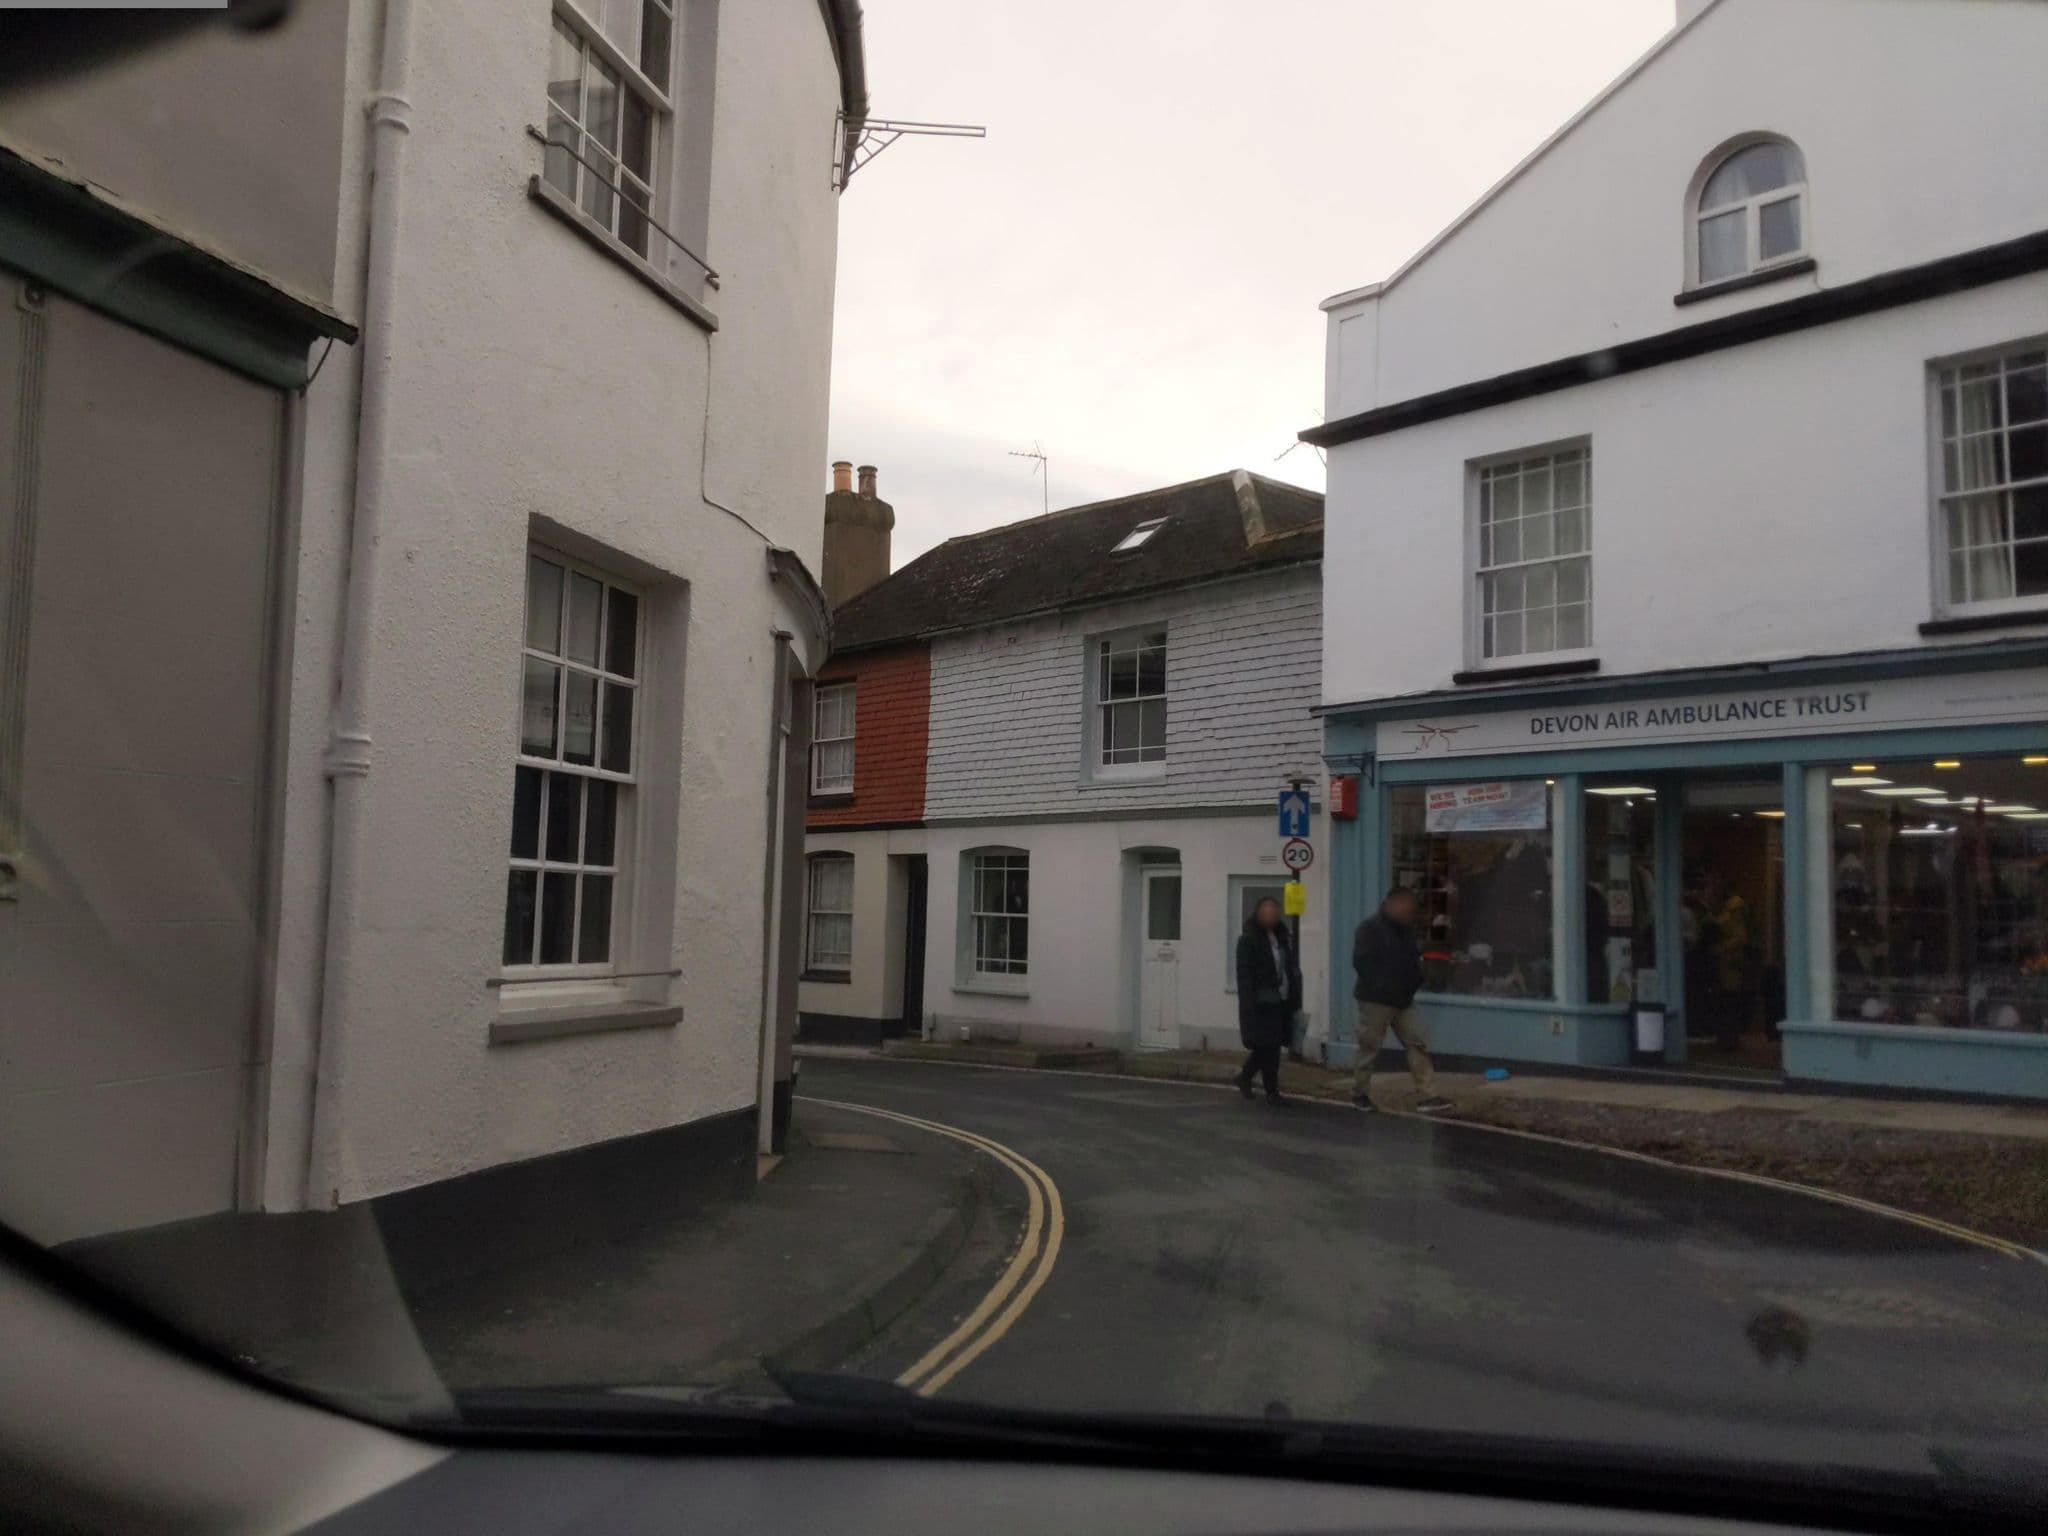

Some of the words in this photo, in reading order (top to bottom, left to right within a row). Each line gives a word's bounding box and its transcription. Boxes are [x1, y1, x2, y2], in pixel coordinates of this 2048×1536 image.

[1531, 712, 1598, 735] DEVON
[1604, 708, 1639, 729] AIR
[1645, 699, 1786, 727] AMBULANCE
[1795, 692, 1871, 717] TRUST
[1287, 849, 1310, 862] 20
